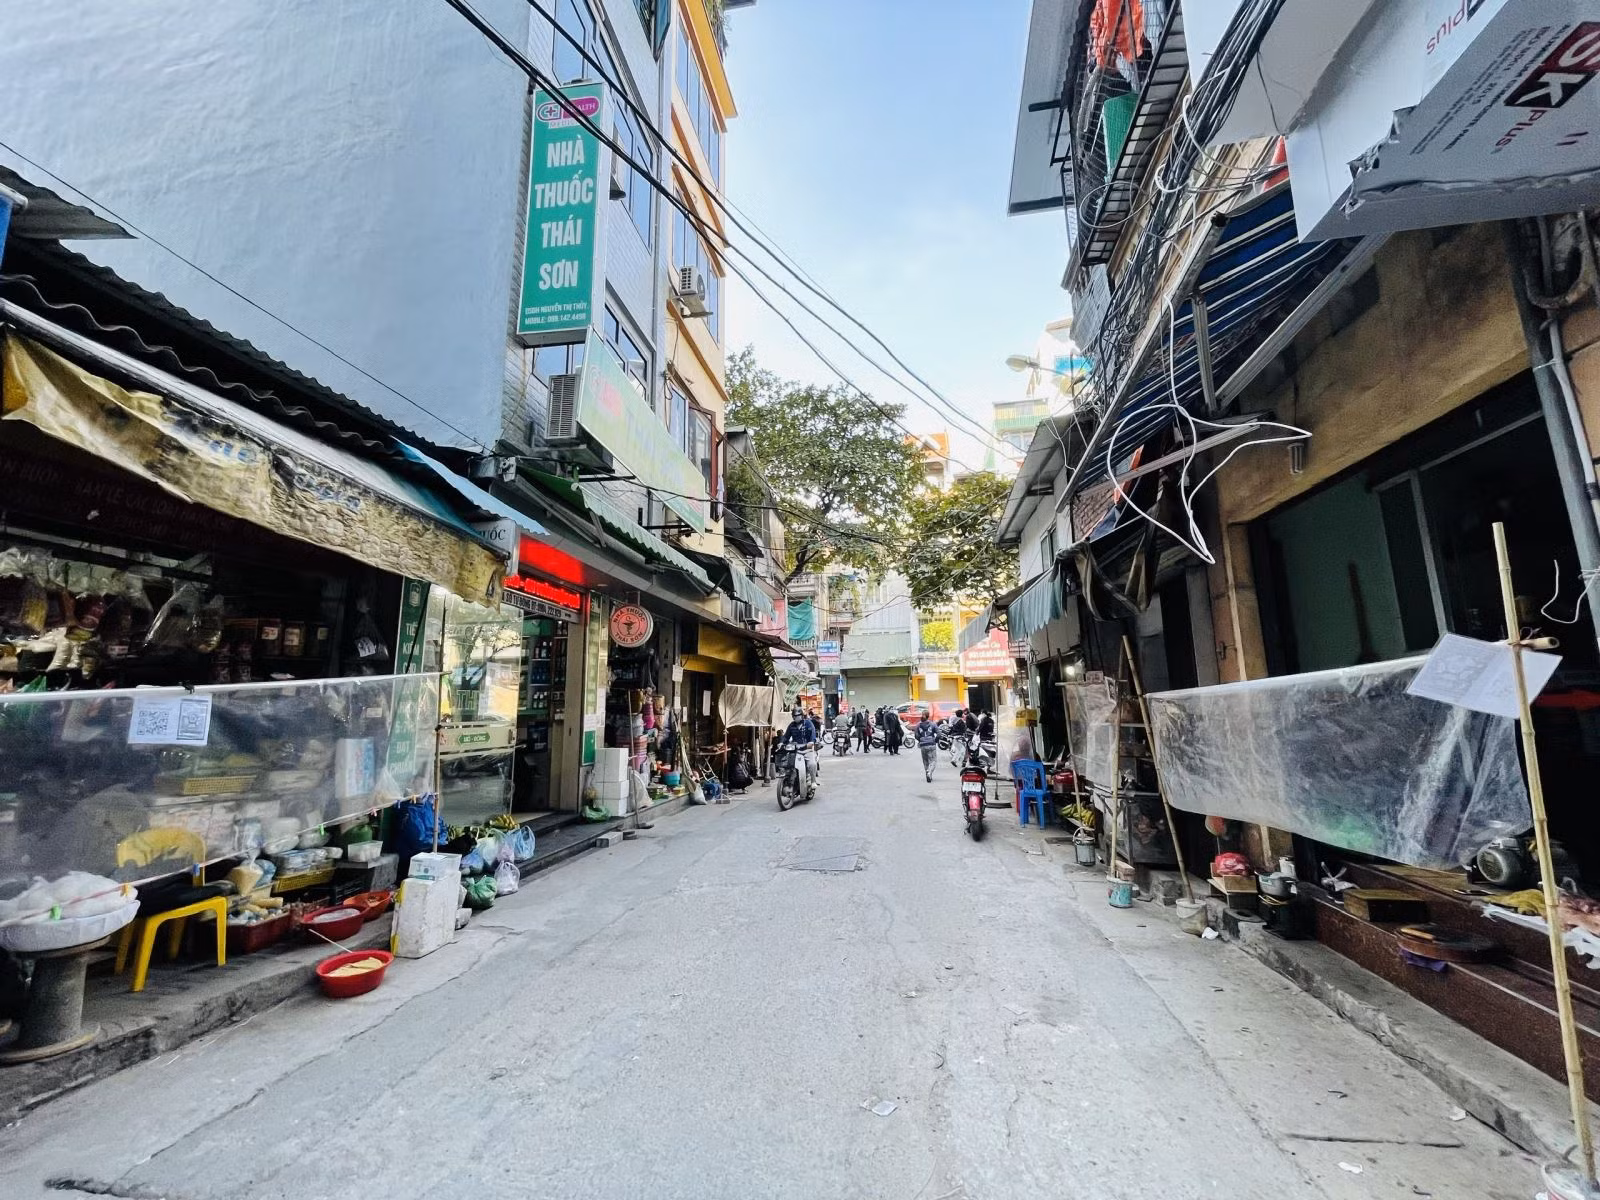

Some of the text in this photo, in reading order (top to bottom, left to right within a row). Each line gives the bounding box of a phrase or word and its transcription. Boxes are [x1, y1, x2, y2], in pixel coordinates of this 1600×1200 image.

[547, 134, 585, 168] NHÀ
[535, 170, 594, 208] THUỐC
[541, 214, 582, 248] THÁI
[539, 259, 579, 290] SƠN
